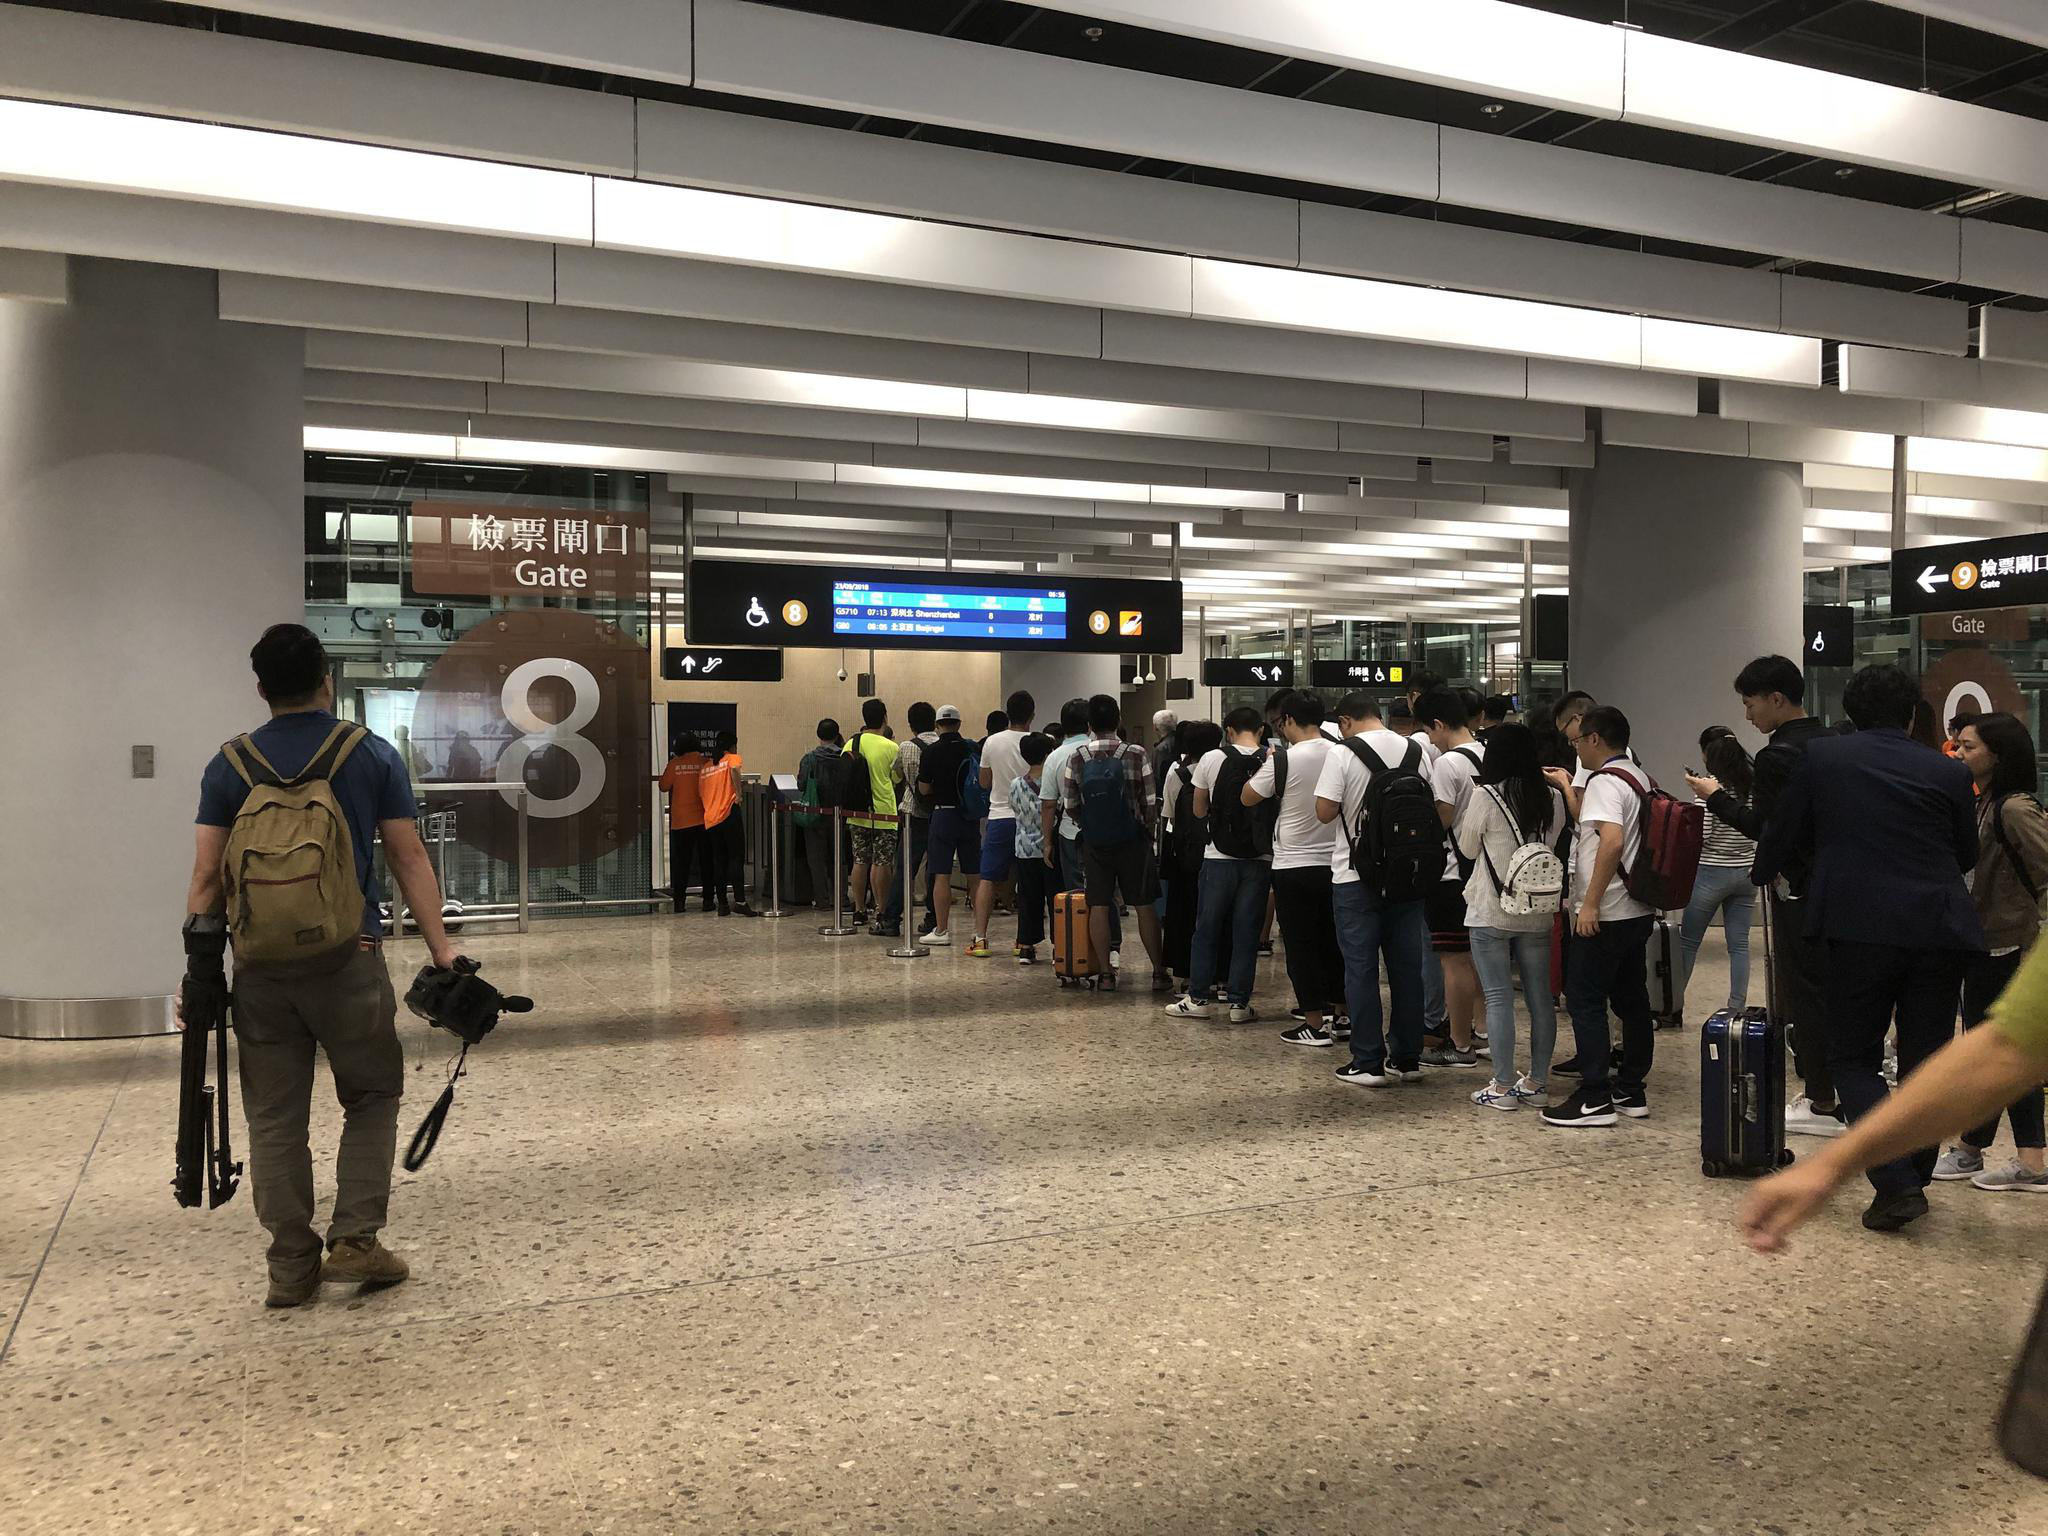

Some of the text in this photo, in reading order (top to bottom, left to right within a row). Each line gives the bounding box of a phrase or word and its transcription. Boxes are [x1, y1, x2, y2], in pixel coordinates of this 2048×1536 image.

[467, 513, 629, 556] 檢票閘口
[515, 560, 587, 588] Gate
[1980, 554, 2048, 577] 檢票閘口
[1958, 566, 1972, 586] 9
[1980, 579, 2001, 590] Gate
[789, 604, 802, 623] 8
[1093, 614, 1105, 632] 8
[1952, 615, 1985, 634] Gate
[496, 657, 606, 819] 8
